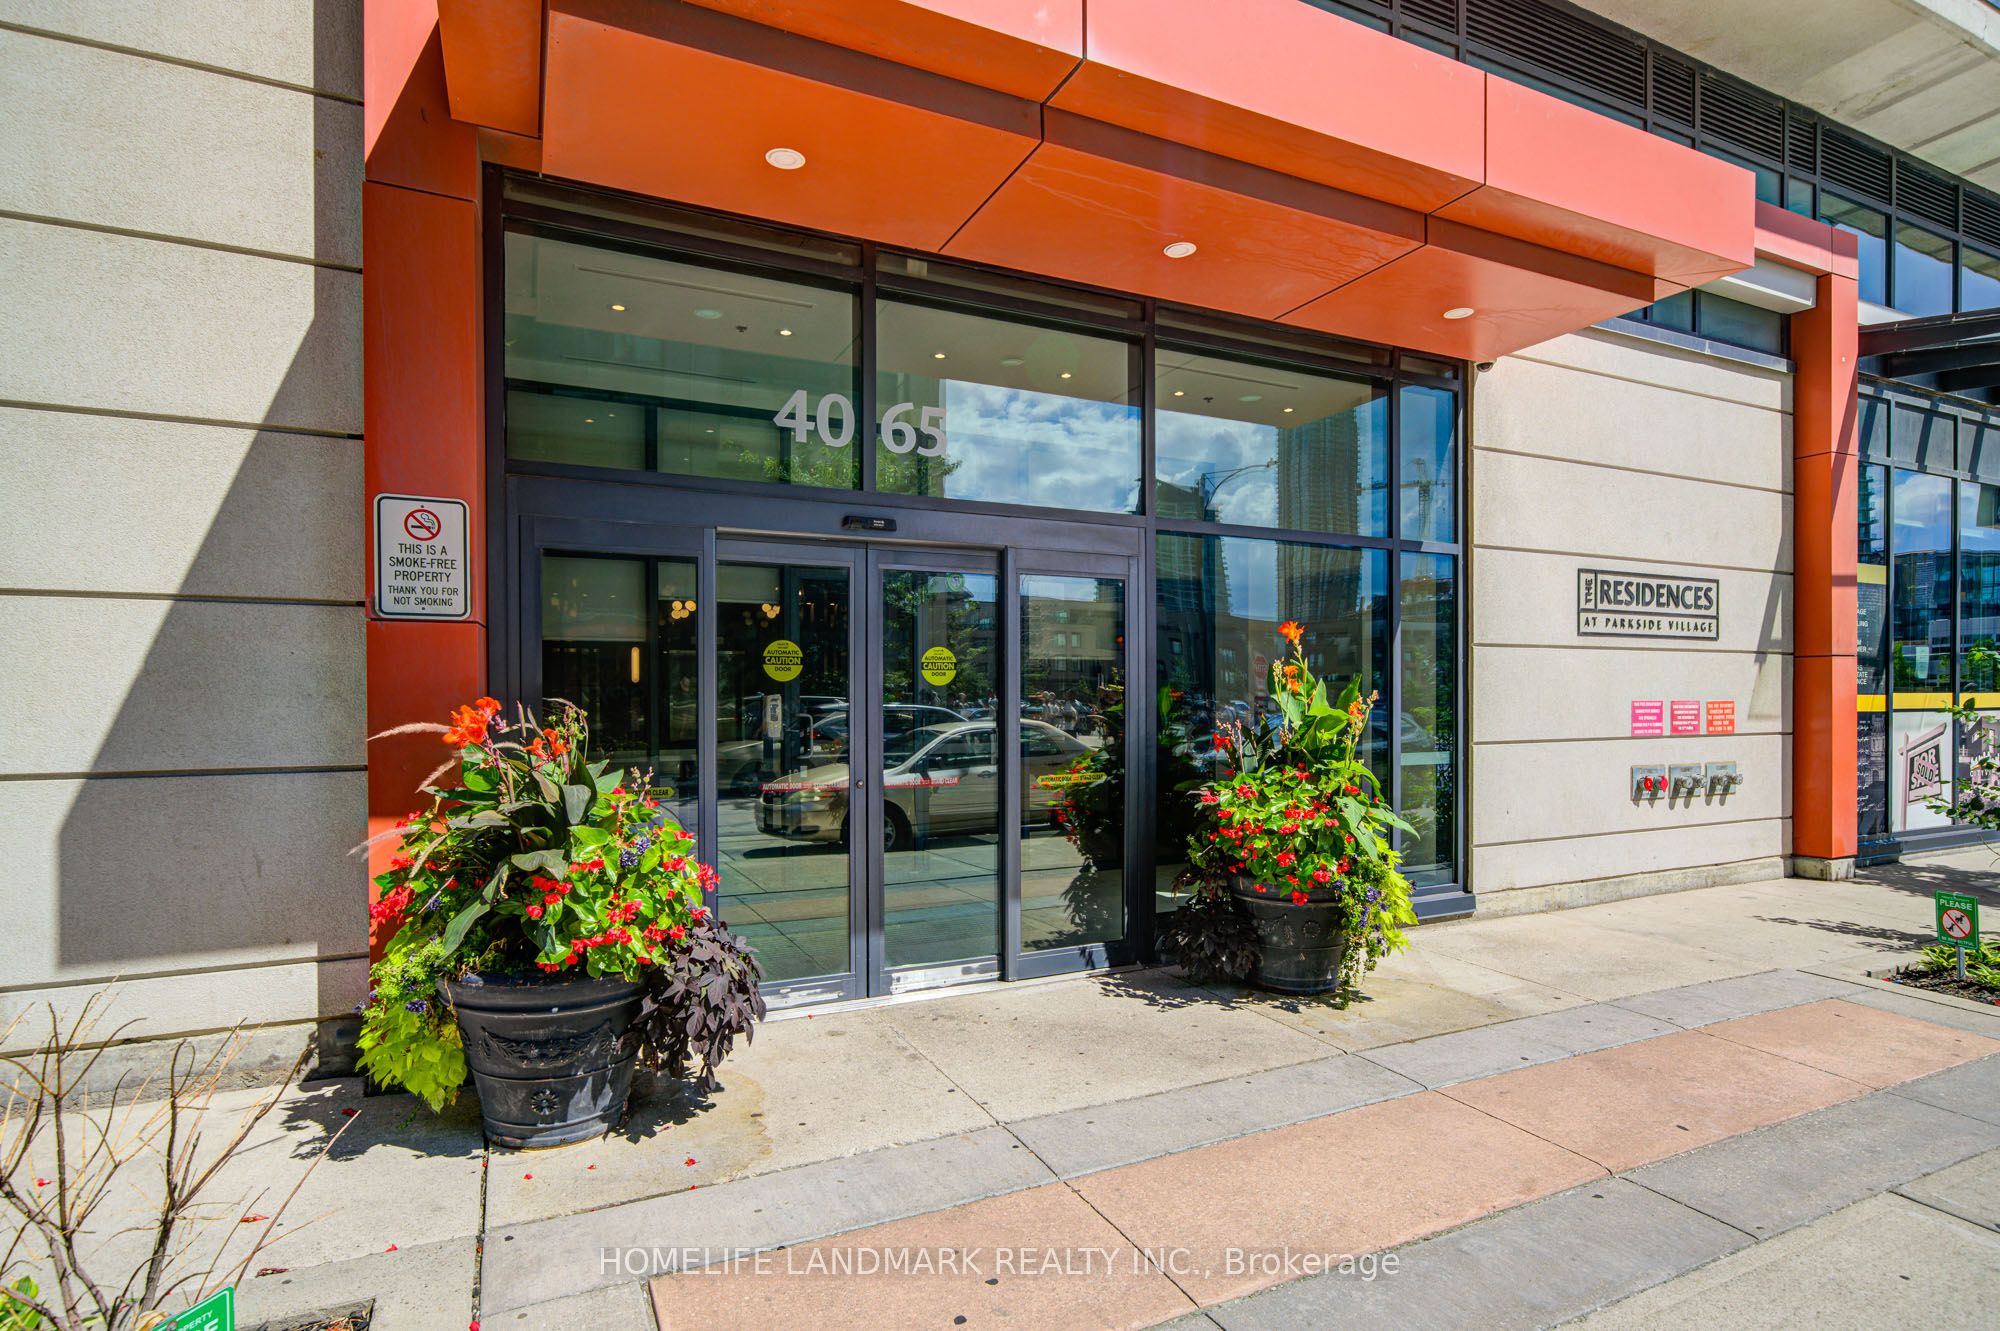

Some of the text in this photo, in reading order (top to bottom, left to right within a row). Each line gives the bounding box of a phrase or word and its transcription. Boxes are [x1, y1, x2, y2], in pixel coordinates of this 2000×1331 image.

[398, 543, 448, 556] THIS IS A
[389, 556, 457, 569] SMOKE-FREE
[394, 570, 451, 582] PROPERTY
[388, 585, 459, 597] THANK YOU FOR
[1584, 578, 1593, 605] THE
[1599, 579, 1714, 610] RESIDENCES
[393, 596, 453, 607] NOT SMOKING
[1584, 616, 1713, 633] AT PARKSIDE VILLAGE
[765, 656, 801, 665] CAUTION
[923, 662, 955, 670] CAUTION
[1916, 763, 1934, 782] SOLD
[1939, 898, 1973, 911] PLEASE
